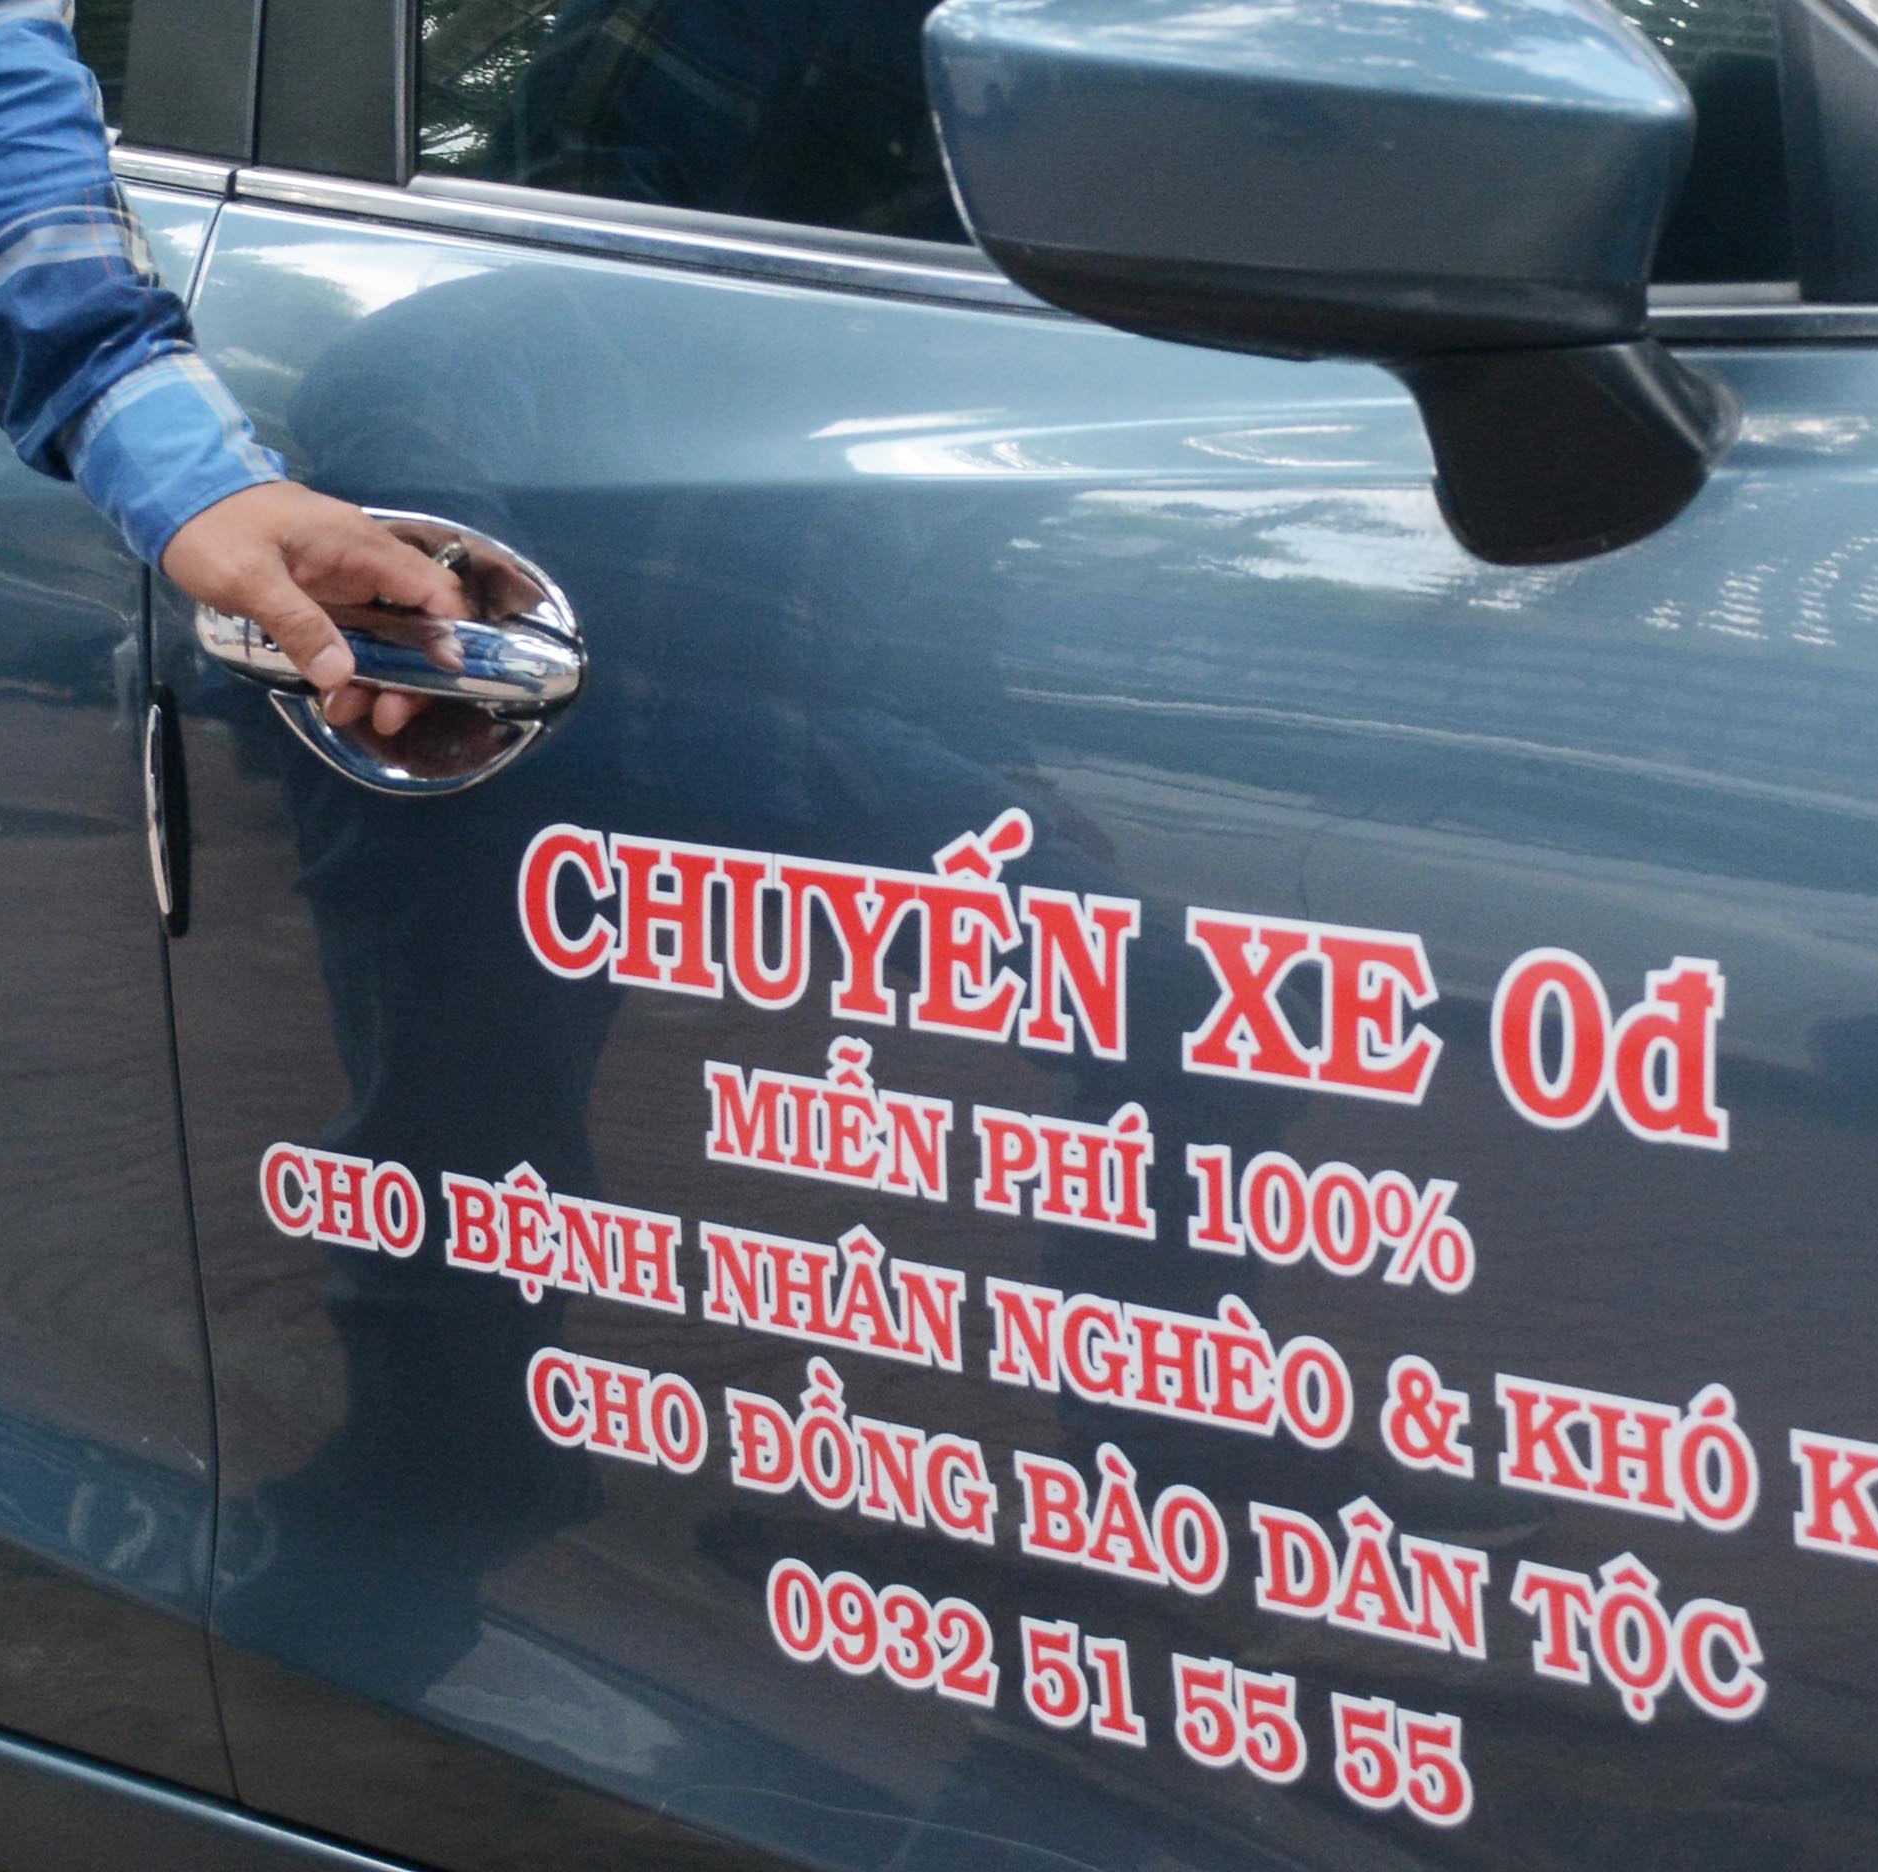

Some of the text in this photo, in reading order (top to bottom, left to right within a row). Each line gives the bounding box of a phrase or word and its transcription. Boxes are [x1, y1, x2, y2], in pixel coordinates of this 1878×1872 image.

[518, 814, 1725, 1145] CHUYẾN XE 0đ
[706, 1041, 1472, 1290] MIỄN PHÍ 100%
[259, 1145, 426, 1256] CHO
[442, 1167, 685, 1312] BỆNH
[700, 1228, 964, 1368] NHÂN
[988, 1284, 1351, 1446] NGHÈO
[1384, 1362, 1471, 1473] &
[1500, 1382, 1756, 1527] KHÓ
[526, 1350, 1761, 1718] CHO ĐỒNG BÀO DÂN TỘC
[767, 1562, 1471, 1823] 0932 51 55 55
